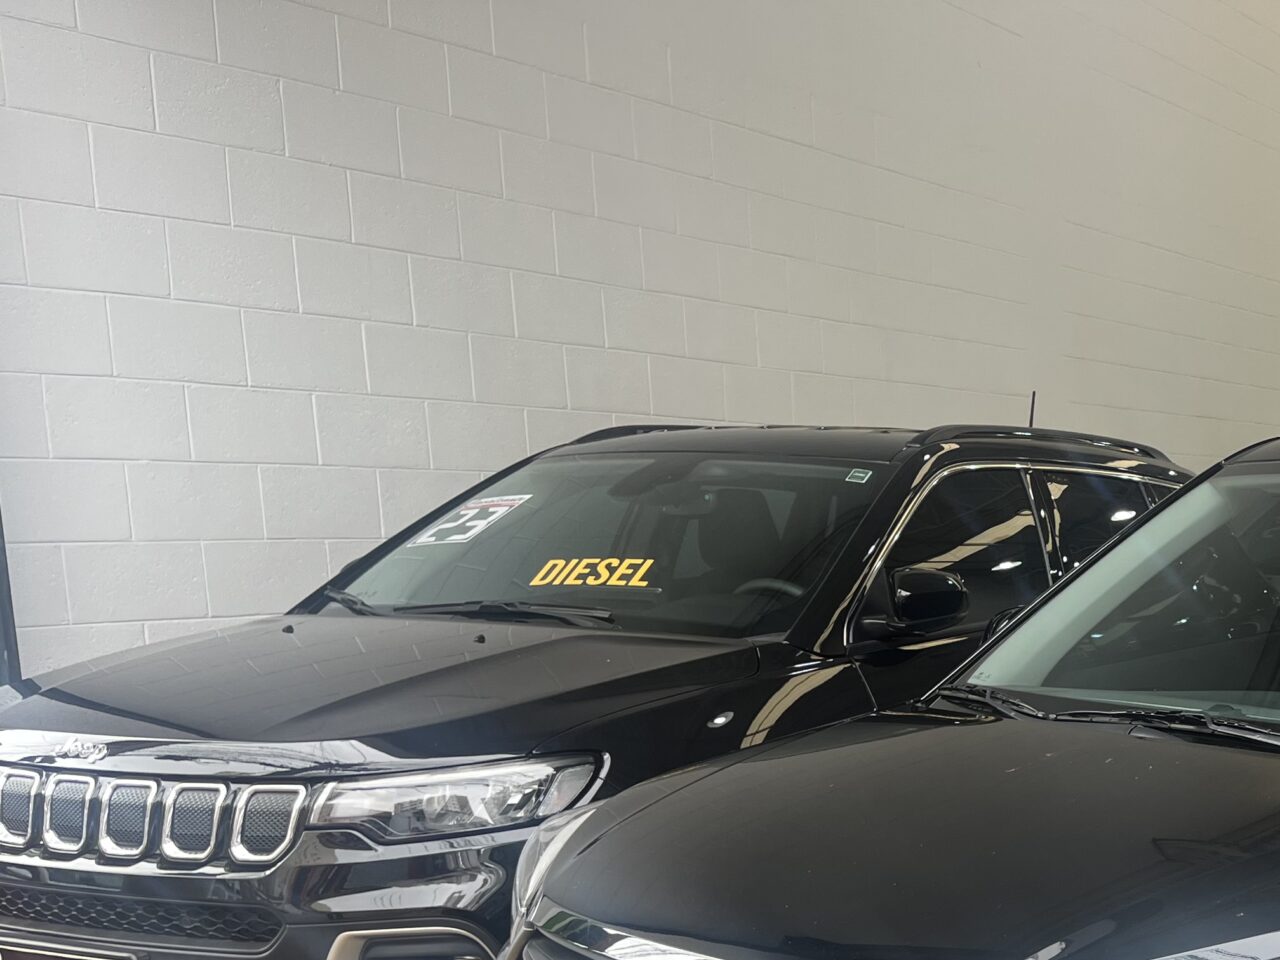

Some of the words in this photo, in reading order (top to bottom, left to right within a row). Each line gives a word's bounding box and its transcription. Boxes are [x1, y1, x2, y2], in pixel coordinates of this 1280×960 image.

[415, 506, 511, 544] 23
[528, 558, 655, 587] DIESEL
[54, 736, 109, 764] Jeep
